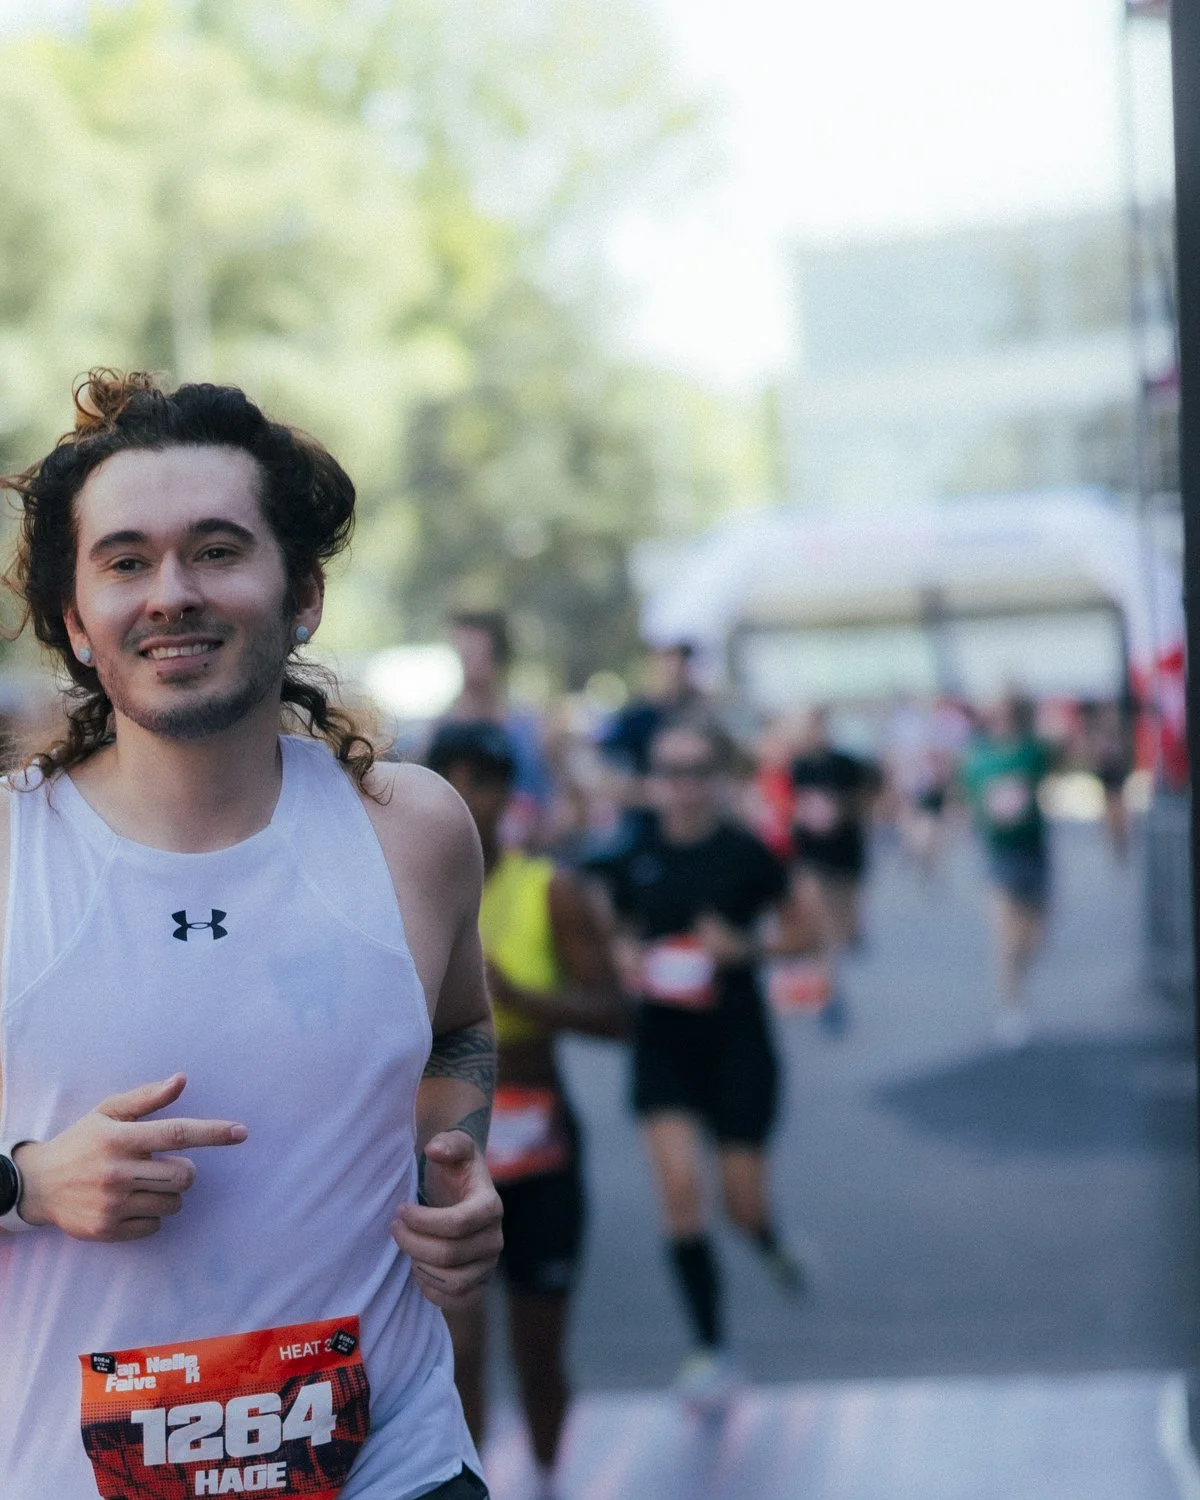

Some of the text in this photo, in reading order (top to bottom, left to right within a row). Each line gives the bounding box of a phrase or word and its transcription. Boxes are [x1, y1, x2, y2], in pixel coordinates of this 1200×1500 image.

[279, 1340, 322, 1361] HEAT
[114, 1360, 141, 1377] an
[131, 1380, 337, 1467] 1264
[194, 1462, 287, 1496] HAGE
